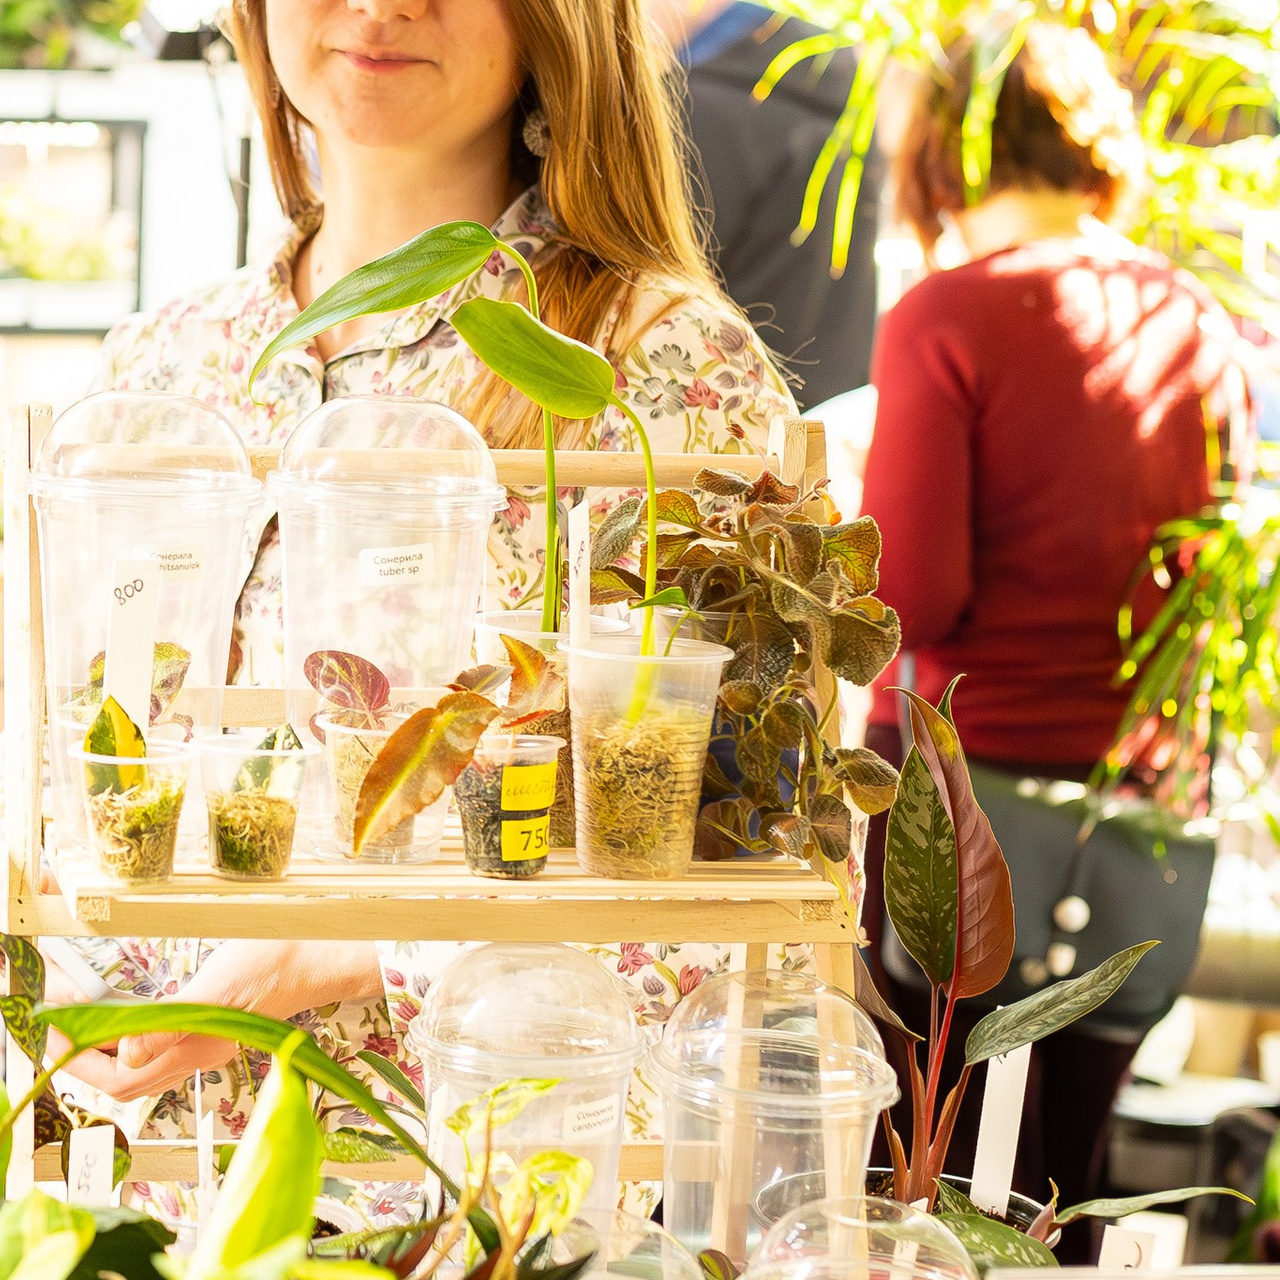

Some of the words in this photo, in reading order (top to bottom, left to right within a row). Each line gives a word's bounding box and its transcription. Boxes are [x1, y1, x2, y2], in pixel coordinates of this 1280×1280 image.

[374, 553, 423, 565] Сонерила
[160, 562, 200, 571] hitsanulok
[379, 567, 405, 577] tuber
[408, 566, 420, 575] sp
[114, 578, 144, 606] 800
